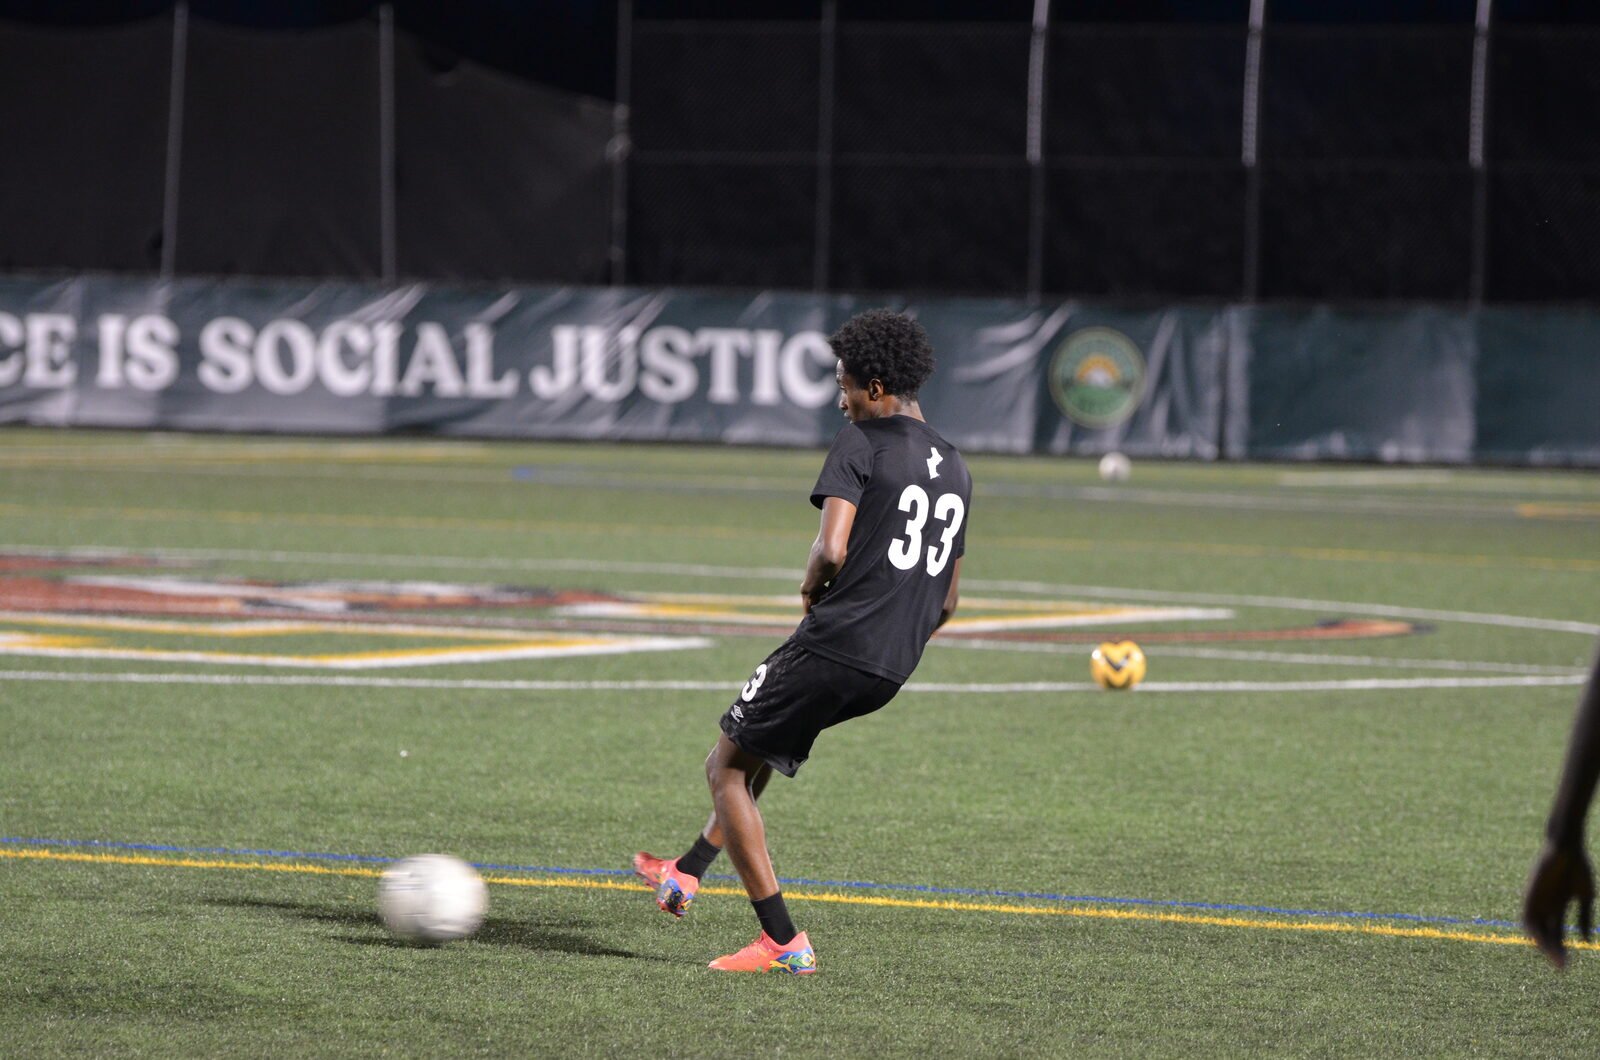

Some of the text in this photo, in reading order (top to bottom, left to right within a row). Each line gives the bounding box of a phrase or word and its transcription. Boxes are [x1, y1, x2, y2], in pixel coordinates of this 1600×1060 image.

[97, 314, 180, 391] IS
[199, 317, 519, 398] SOCIAL
[887, 484, 965, 577] 33
[741, 663, 767, 702] 3
